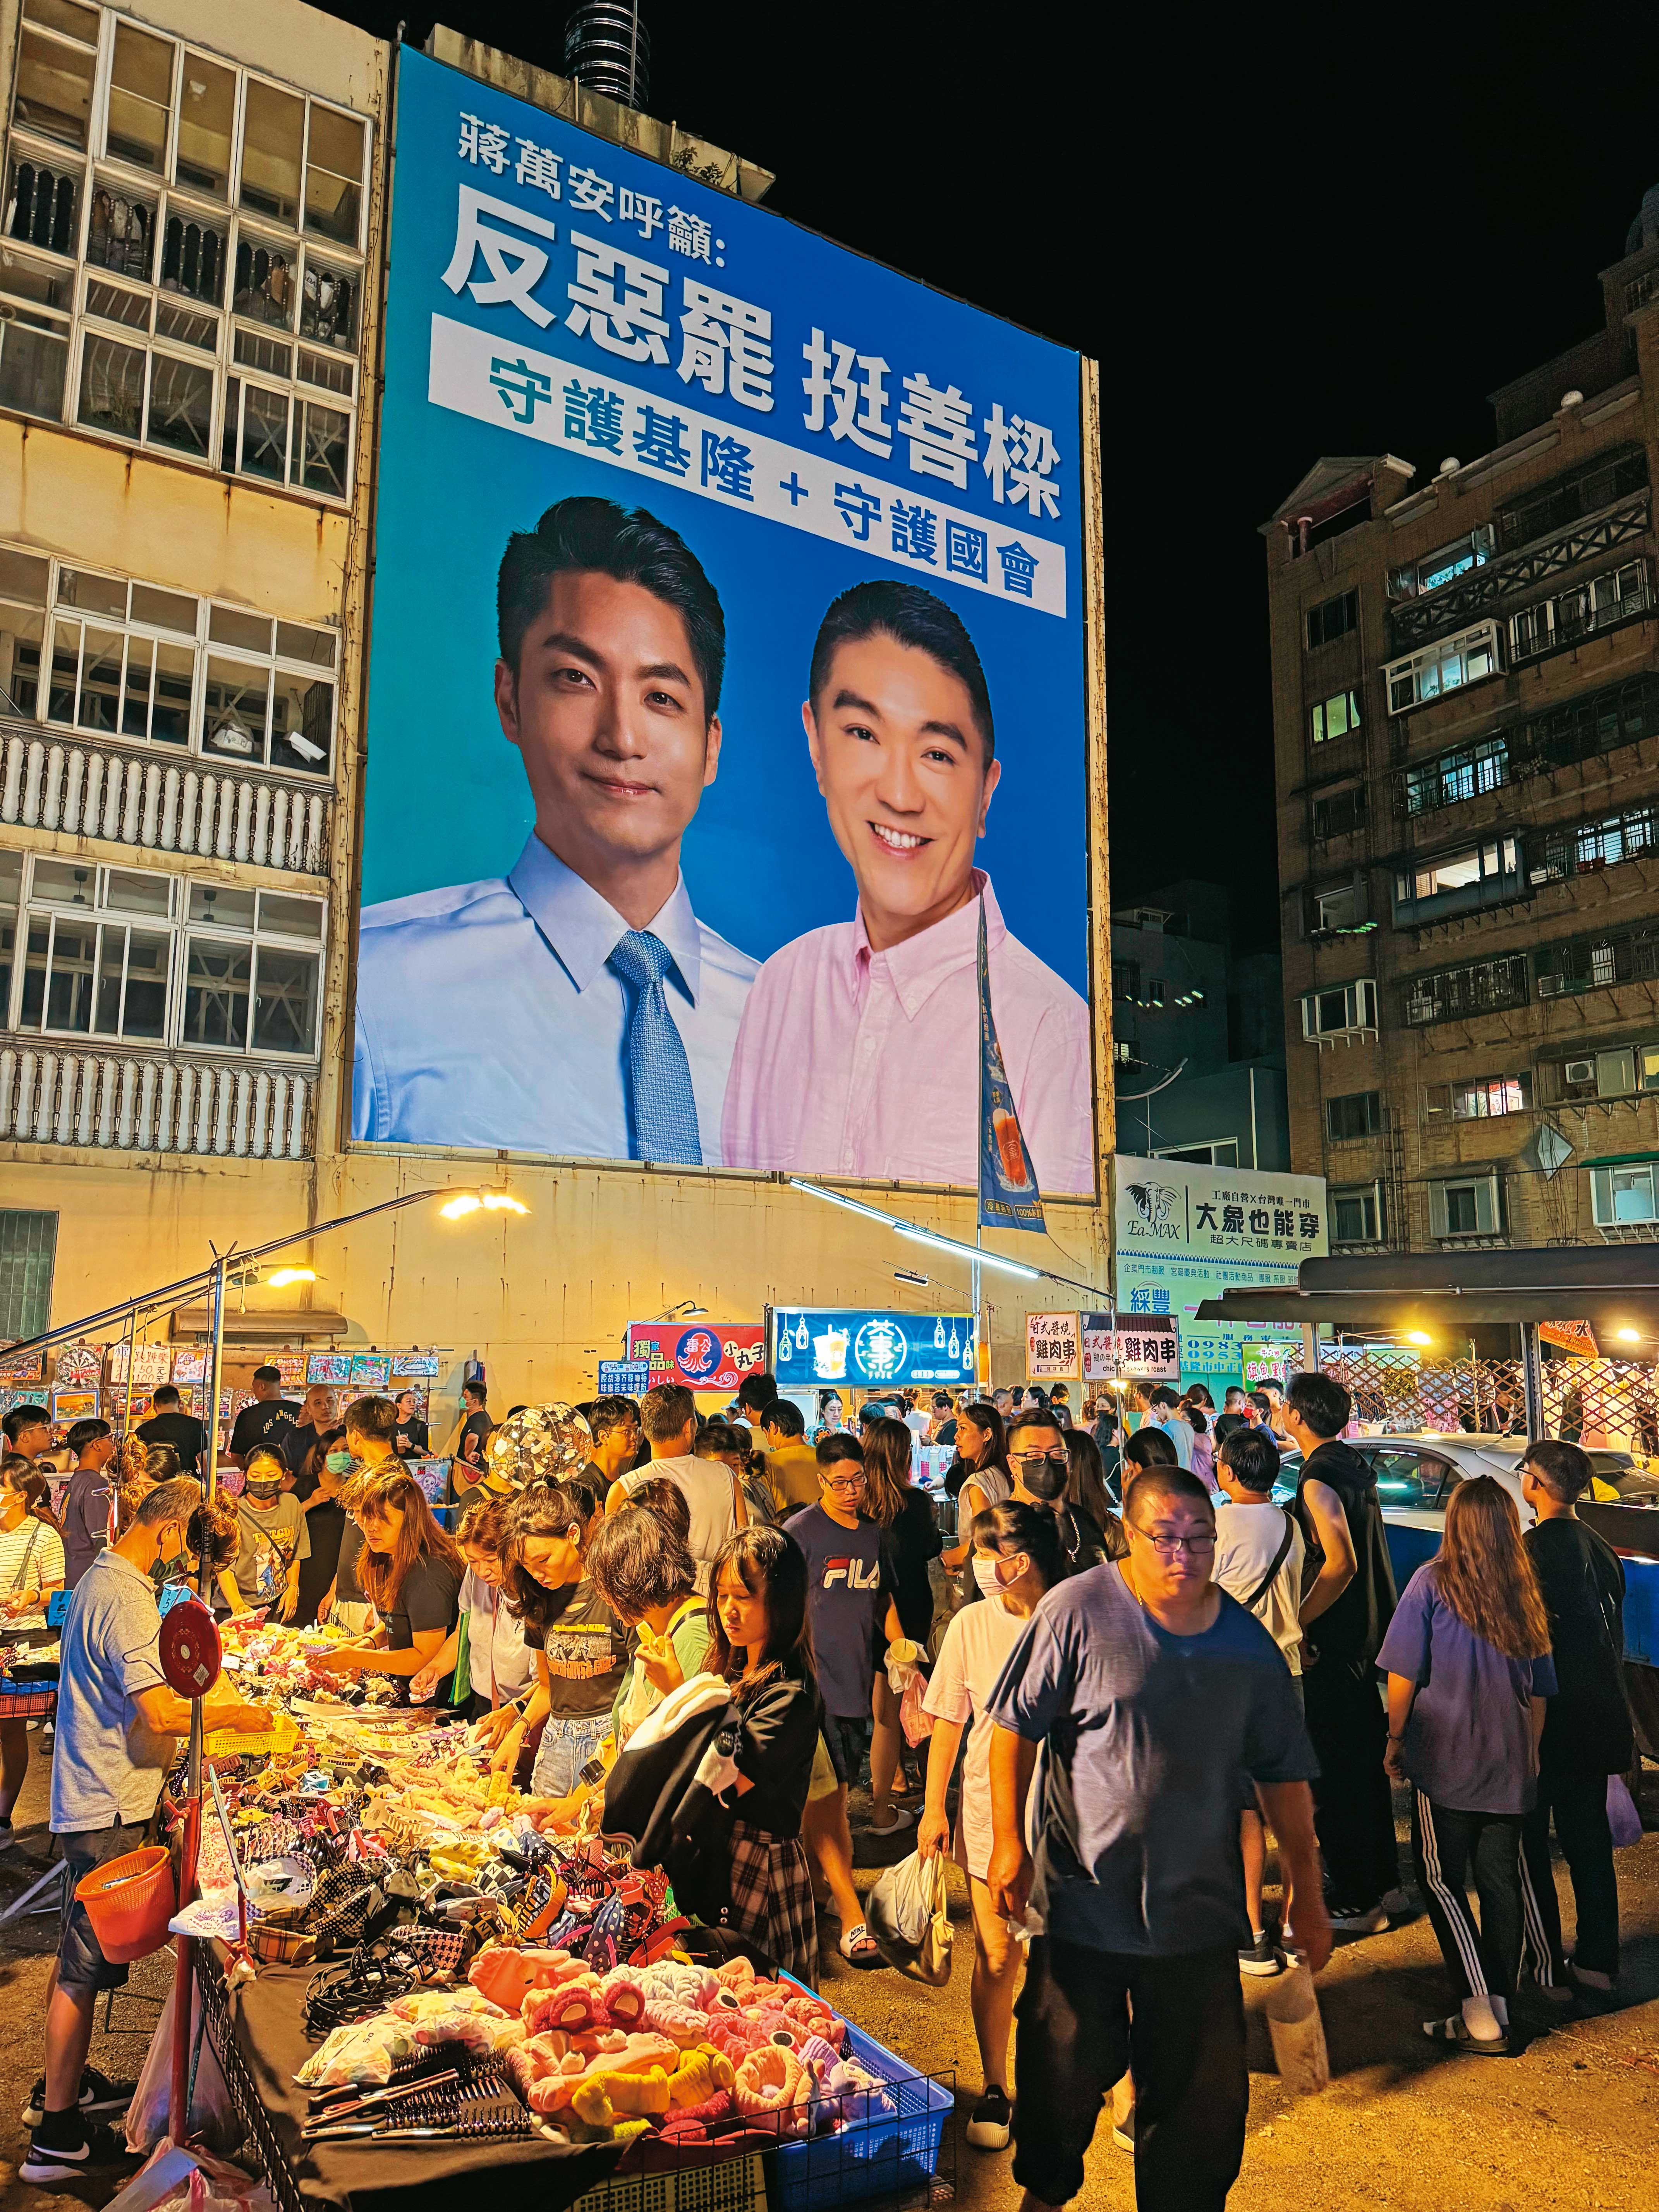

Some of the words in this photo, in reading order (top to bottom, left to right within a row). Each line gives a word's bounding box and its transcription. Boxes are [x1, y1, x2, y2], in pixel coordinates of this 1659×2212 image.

[441, 183, 774, 412] 反惡罷
[802, 327, 1060, 519] 挺善樑
[489, 359, 754, 503] 守護基隆
[834, 483, 1039, 598] 守護國會
[1196, 1203, 1319, 1238] 大象也能穿
[1210, 1234, 1312, 1251] 超大尺碼專賣店
[1033, 1321, 1070, 1336] 日式醬燒
[725, 1343, 764, 1369] 小丸子
[1036, 1339, 1075, 1359] 雞肉串
[1125, 1337, 1175, 1363] 雞肉串
[1180, 1360, 1242, 1372] 基隆市中正
[263, 1419, 273, 1434] LOS
[823, 1558, 880, 1589] FILA
[851, 1926, 865, 1937] NIKE
